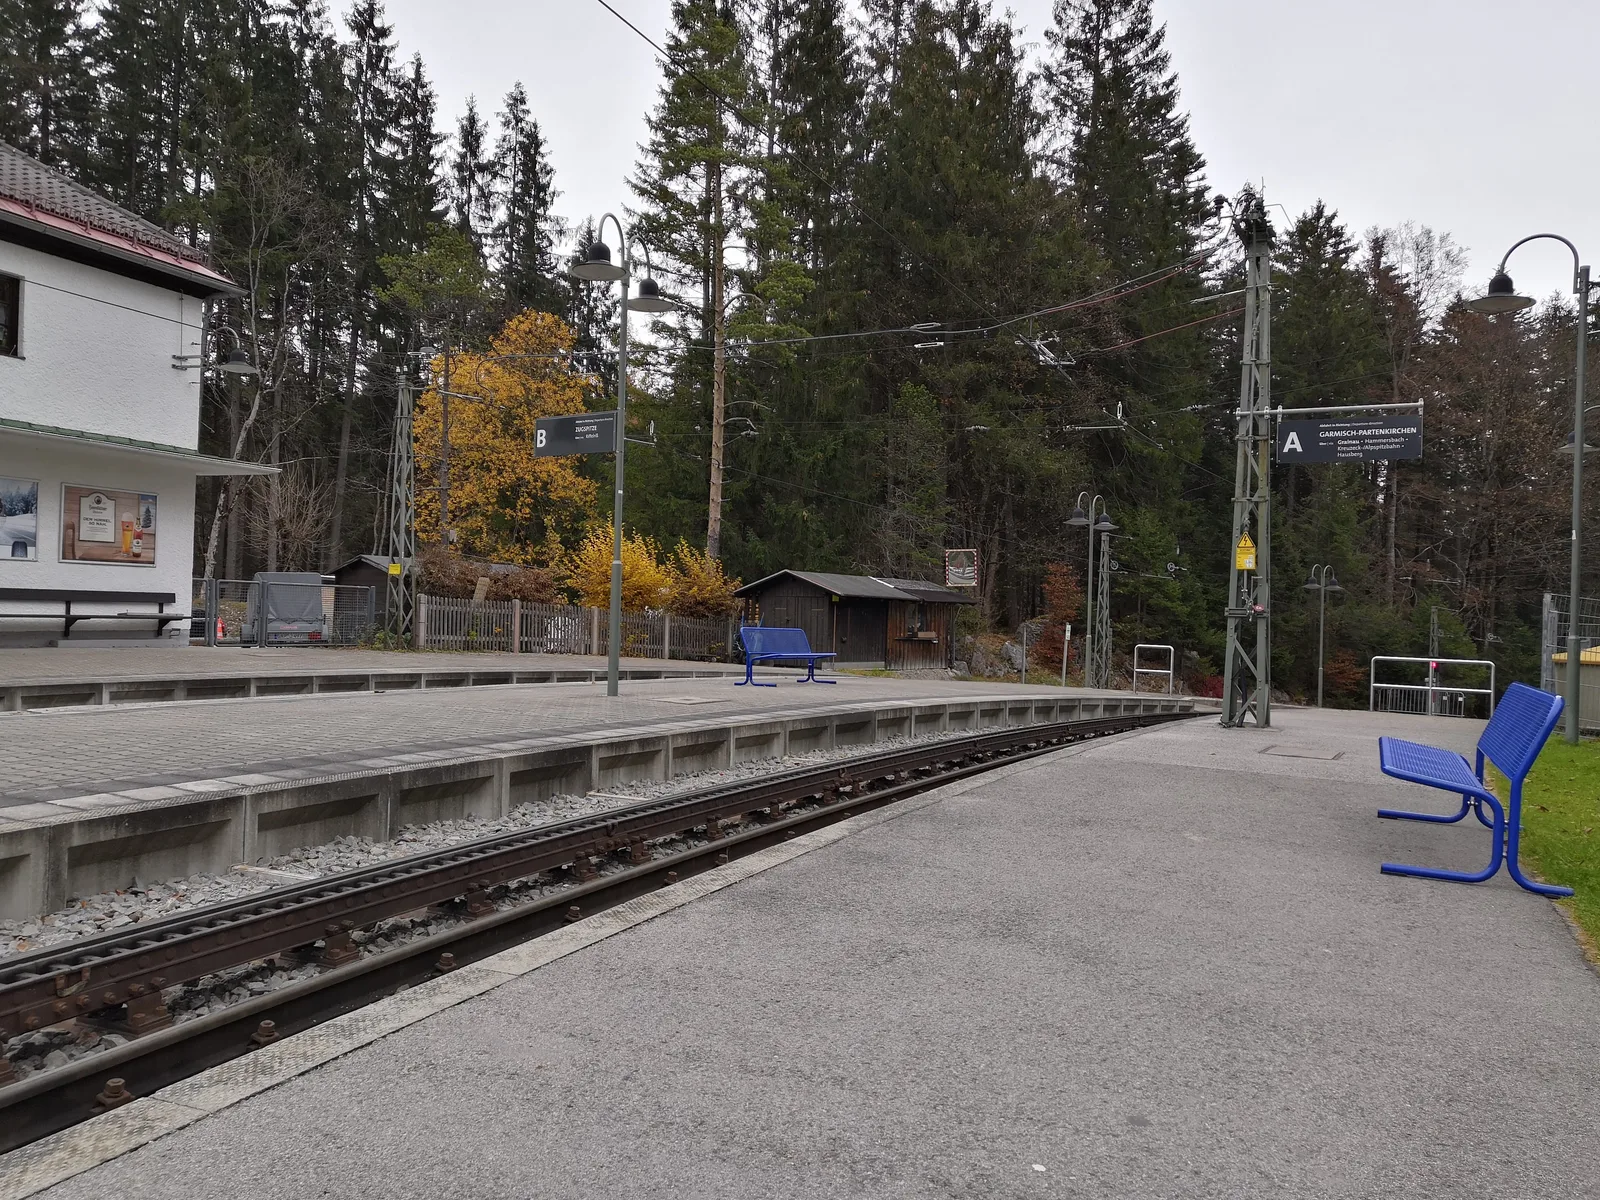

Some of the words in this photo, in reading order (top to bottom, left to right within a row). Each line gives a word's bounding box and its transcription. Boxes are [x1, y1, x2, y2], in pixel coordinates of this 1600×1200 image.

[536, 430, 546, 448] B
[1319, 427, 1417, 438] GARMISCH-PARTENKIRCHEN
[1282, 432, 1304, 452] A
